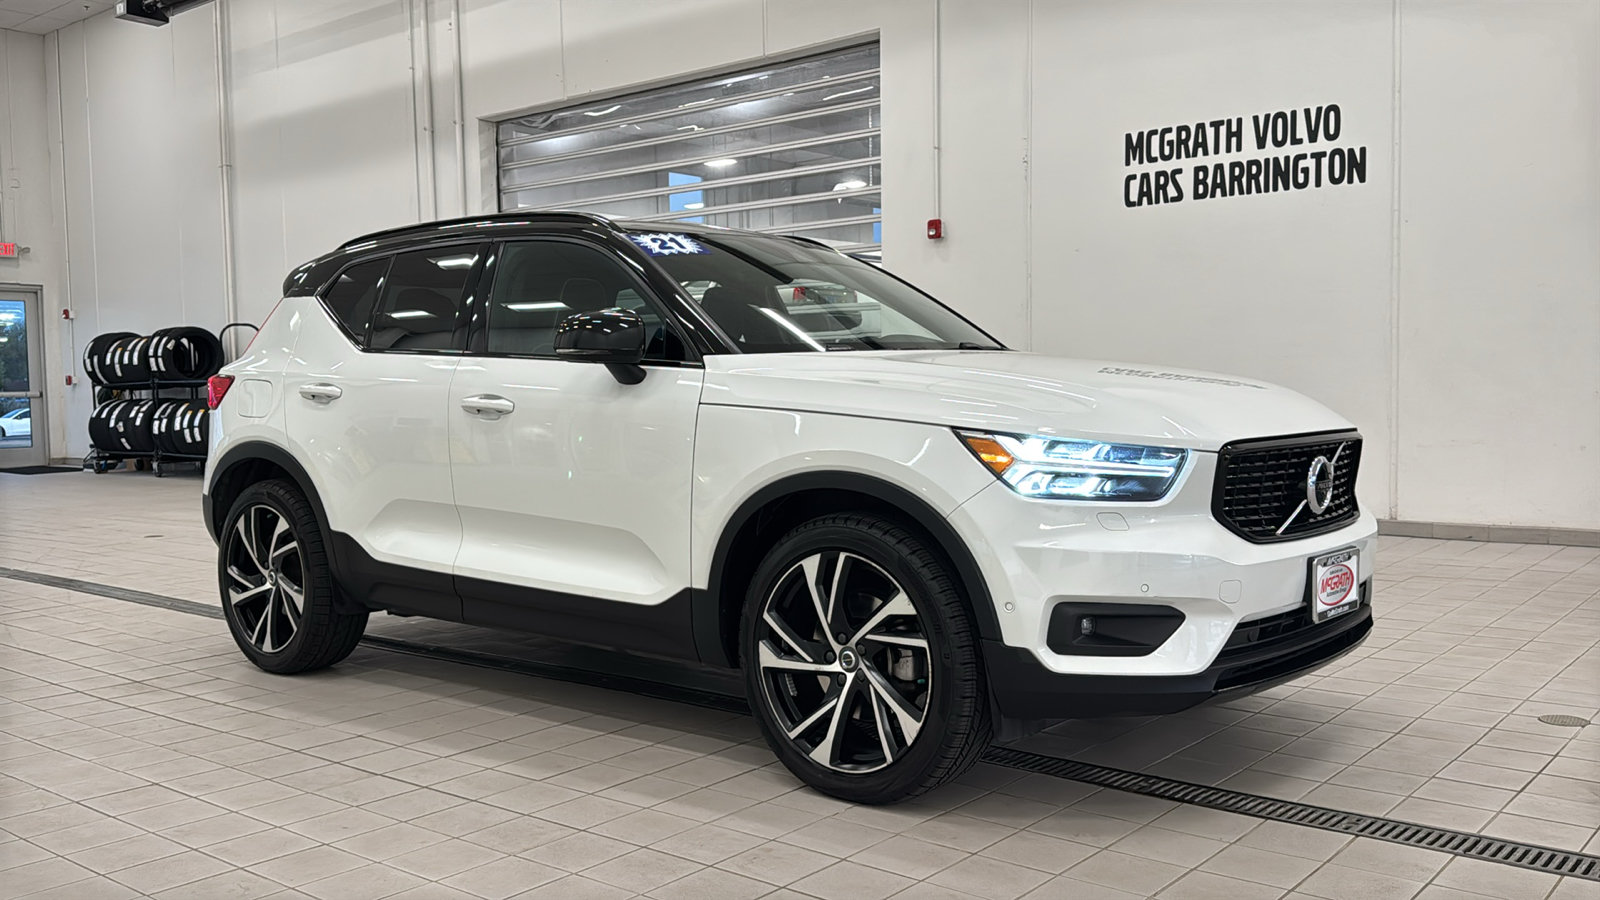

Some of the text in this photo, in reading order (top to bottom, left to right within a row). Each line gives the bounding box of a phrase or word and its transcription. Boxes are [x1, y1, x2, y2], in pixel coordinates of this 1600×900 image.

[1125, 104, 1341, 166] MCGRATH VOLVO
[1124, 147, 1367, 208] CARS BARRINGTON
